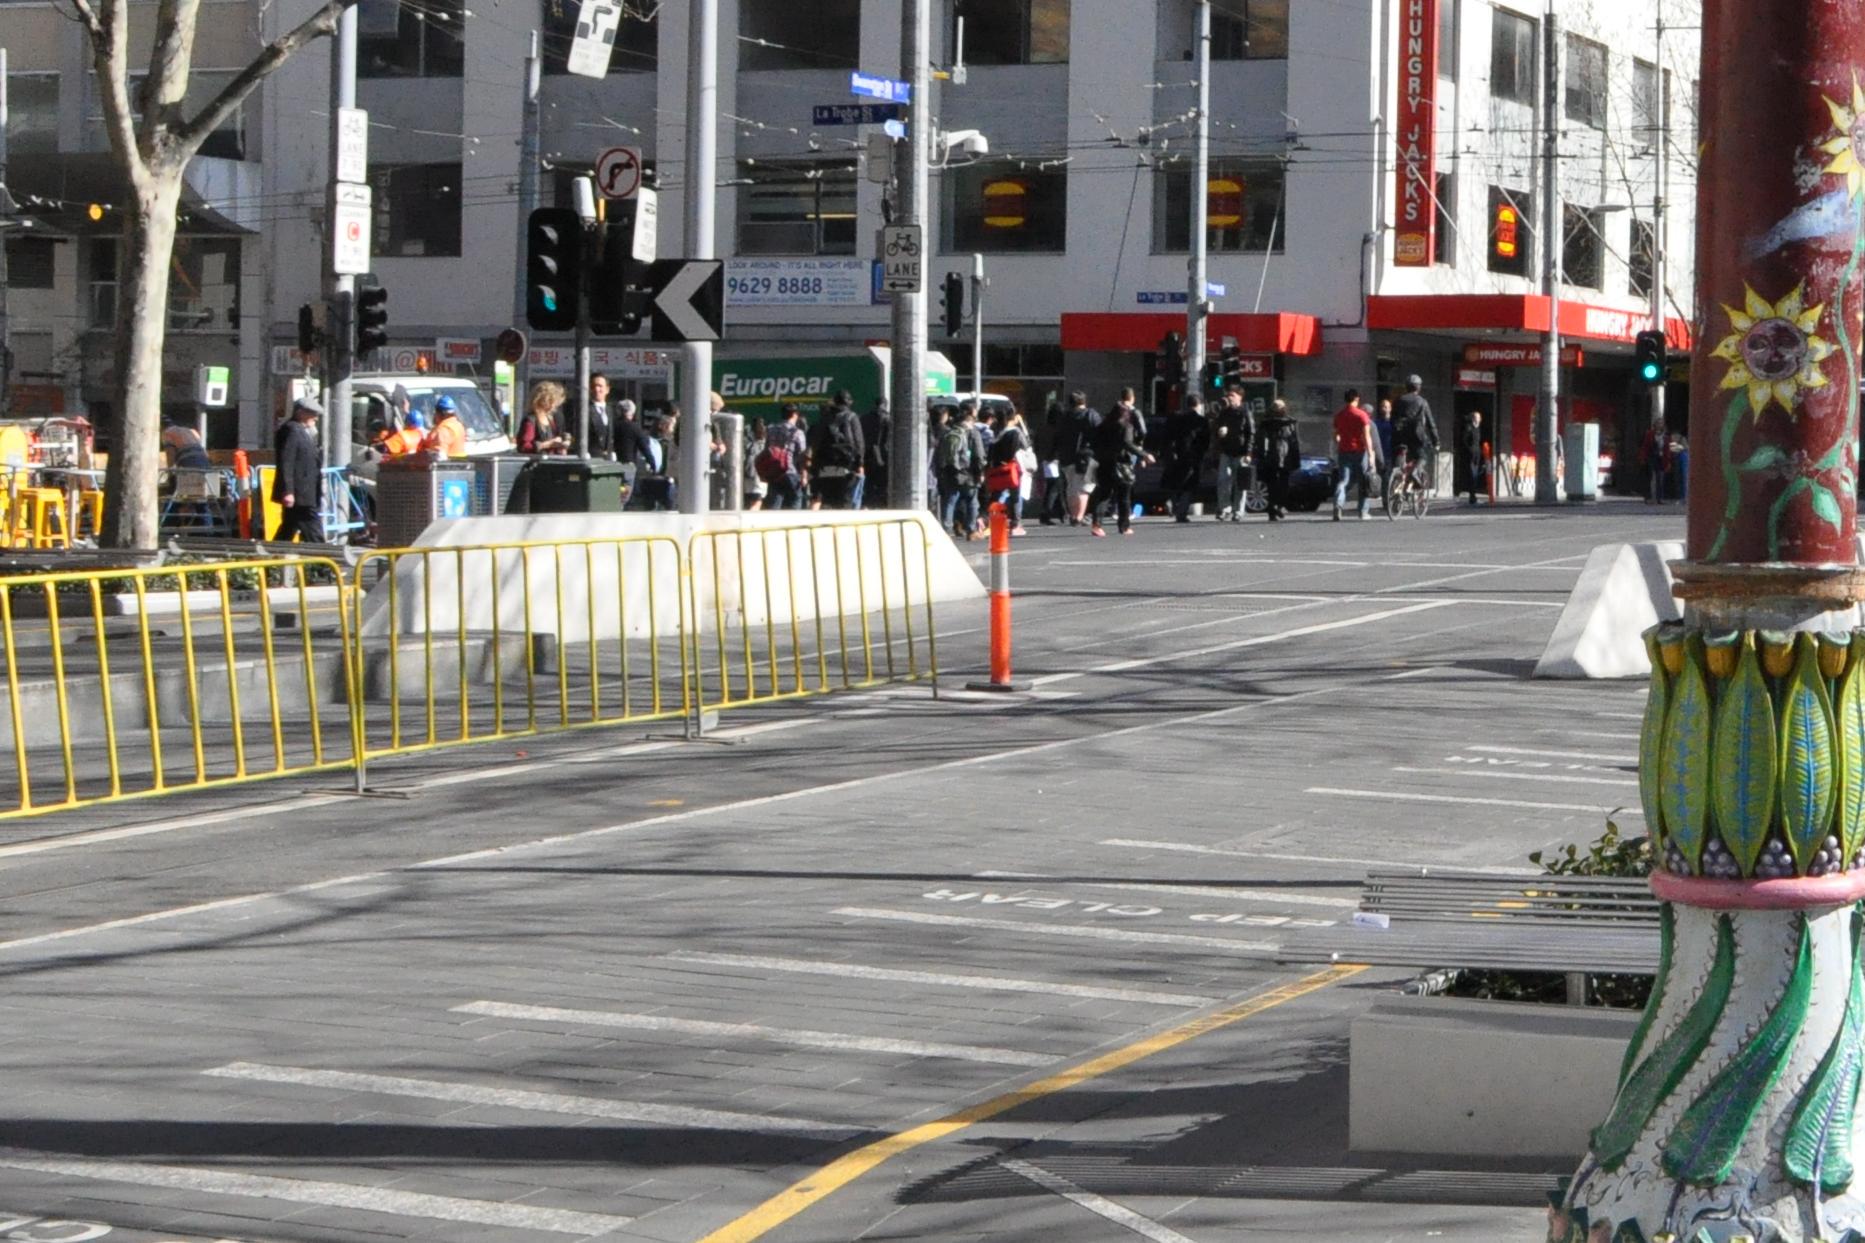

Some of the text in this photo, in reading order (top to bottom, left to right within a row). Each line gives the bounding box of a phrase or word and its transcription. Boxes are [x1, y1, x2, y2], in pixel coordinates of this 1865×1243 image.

[1408, 0, 1422, 113] HUNGRY
[887, 262, 919, 276] LANE
[728, 276, 771, 294] 9629
[777, 277, 823, 294] 8888
[1479, 350, 1526, 361] HUNGRY
[721, 373, 833, 401] Europcar
[922, 888, 1337, 927] CLEAR EEP
